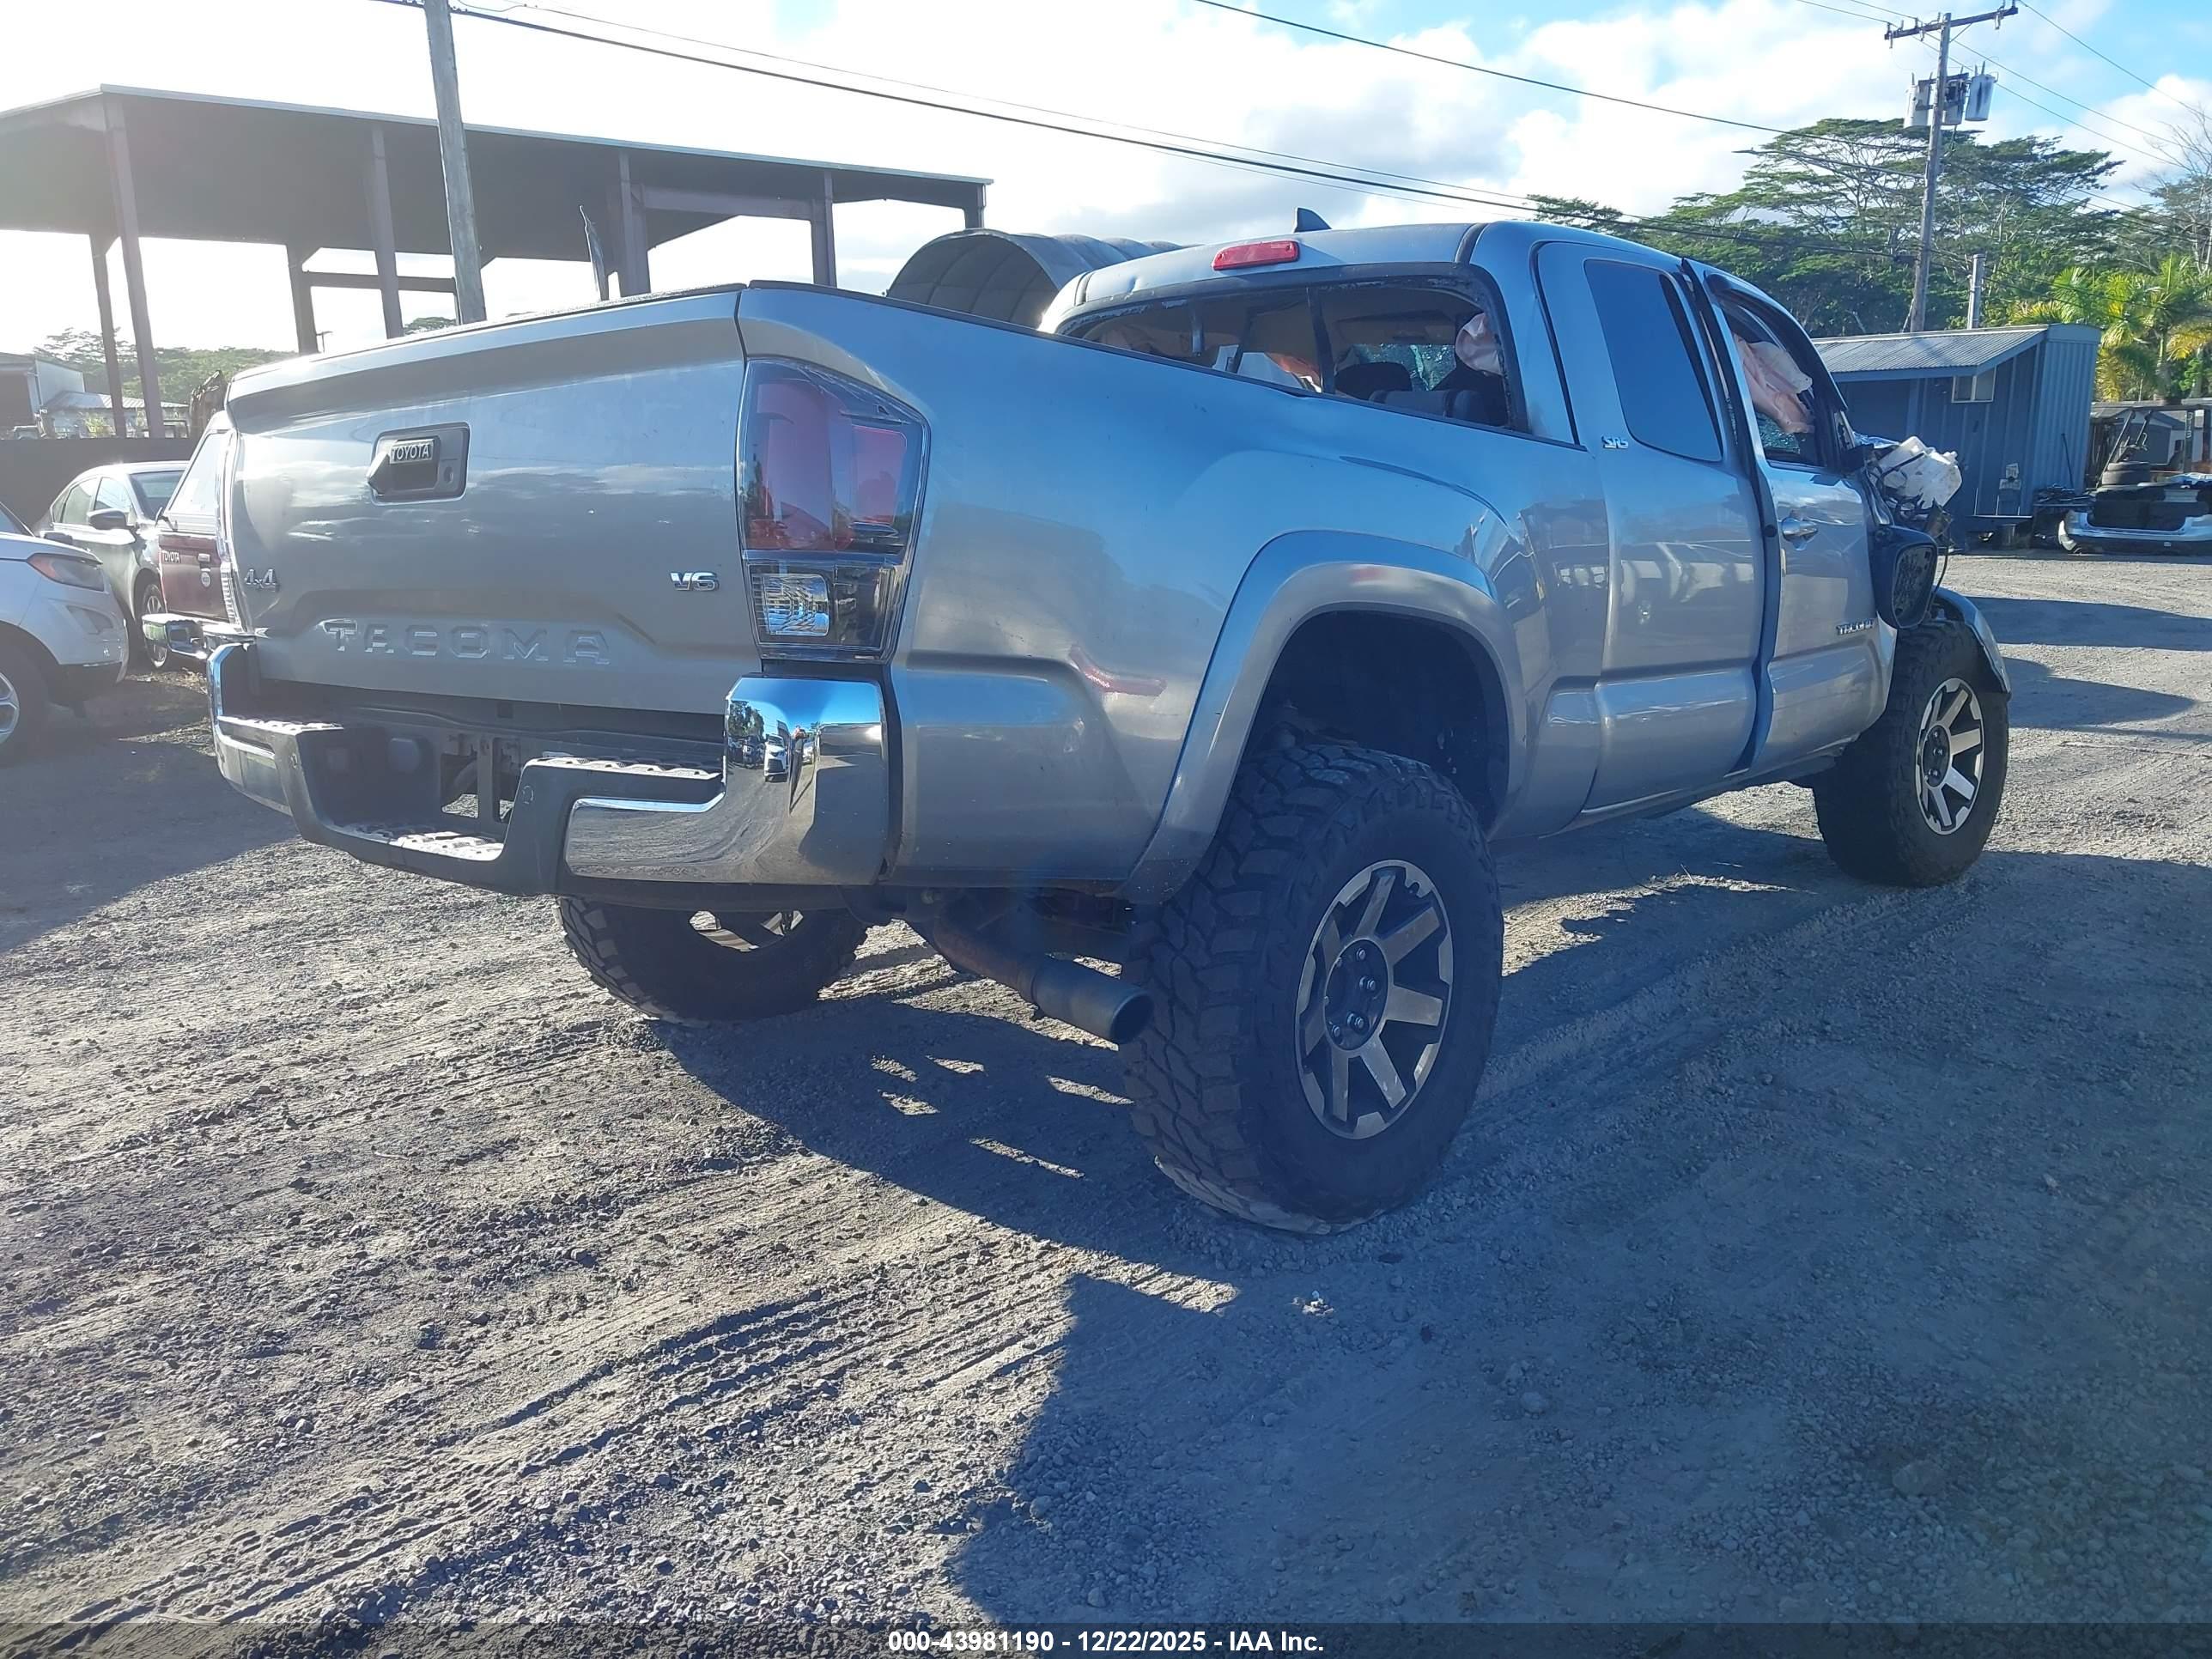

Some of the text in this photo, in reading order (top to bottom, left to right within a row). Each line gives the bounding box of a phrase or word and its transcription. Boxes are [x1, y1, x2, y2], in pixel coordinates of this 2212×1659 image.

[1601, 436, 1629, 449] SR5
[390, 443, 430, 461] TOYOTA
[670, 572, 716, 591] V6
[318, 618, 611, 665] TACOMA
